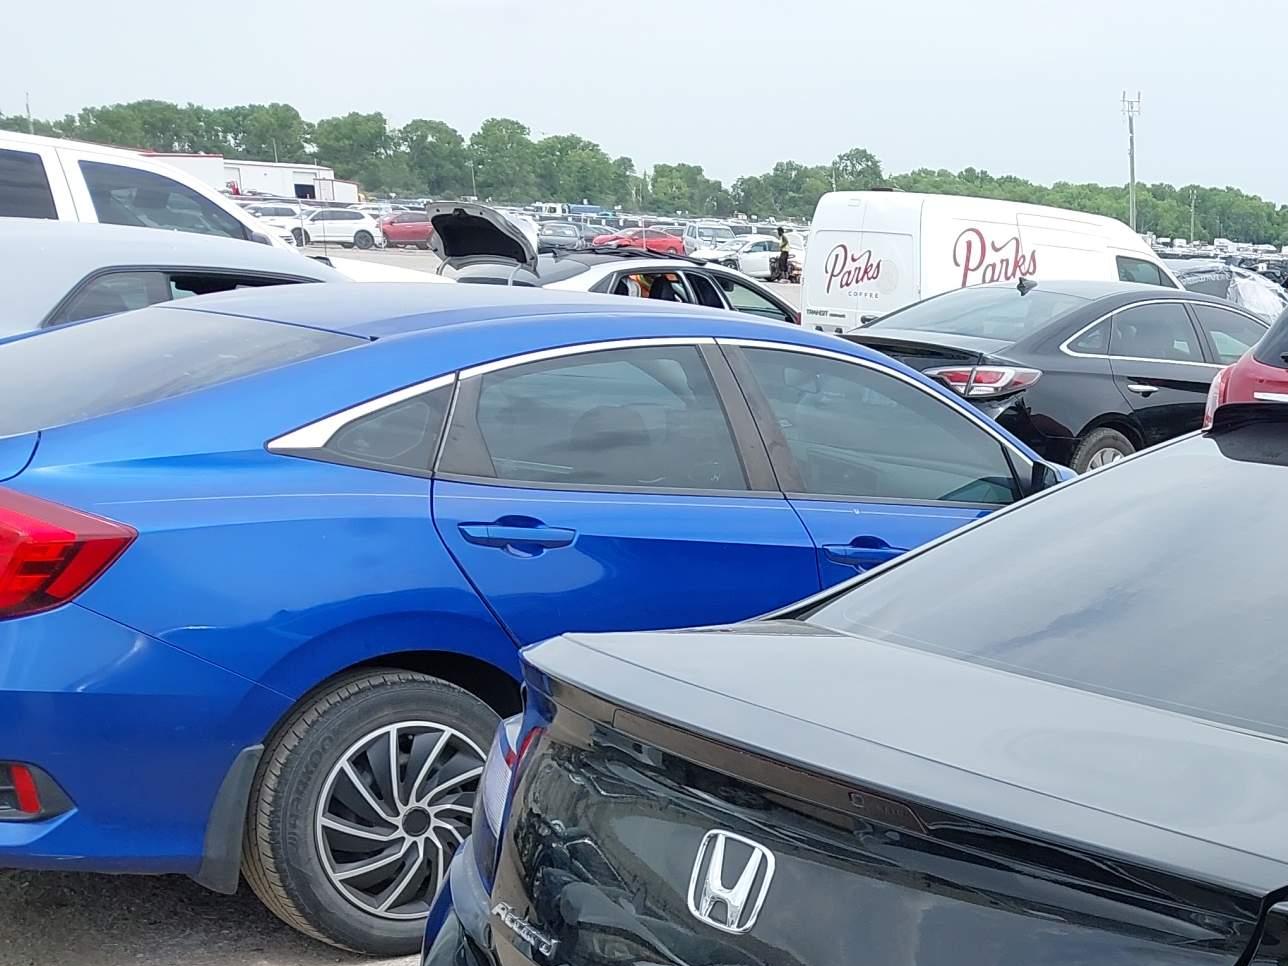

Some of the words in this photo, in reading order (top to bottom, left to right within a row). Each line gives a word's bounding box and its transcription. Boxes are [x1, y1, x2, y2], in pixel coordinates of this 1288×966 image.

[824, 243, 882, 294] Parks
[953, 227, 1037, 288] Parks
[847, 290, 879, 299] COFFEE
